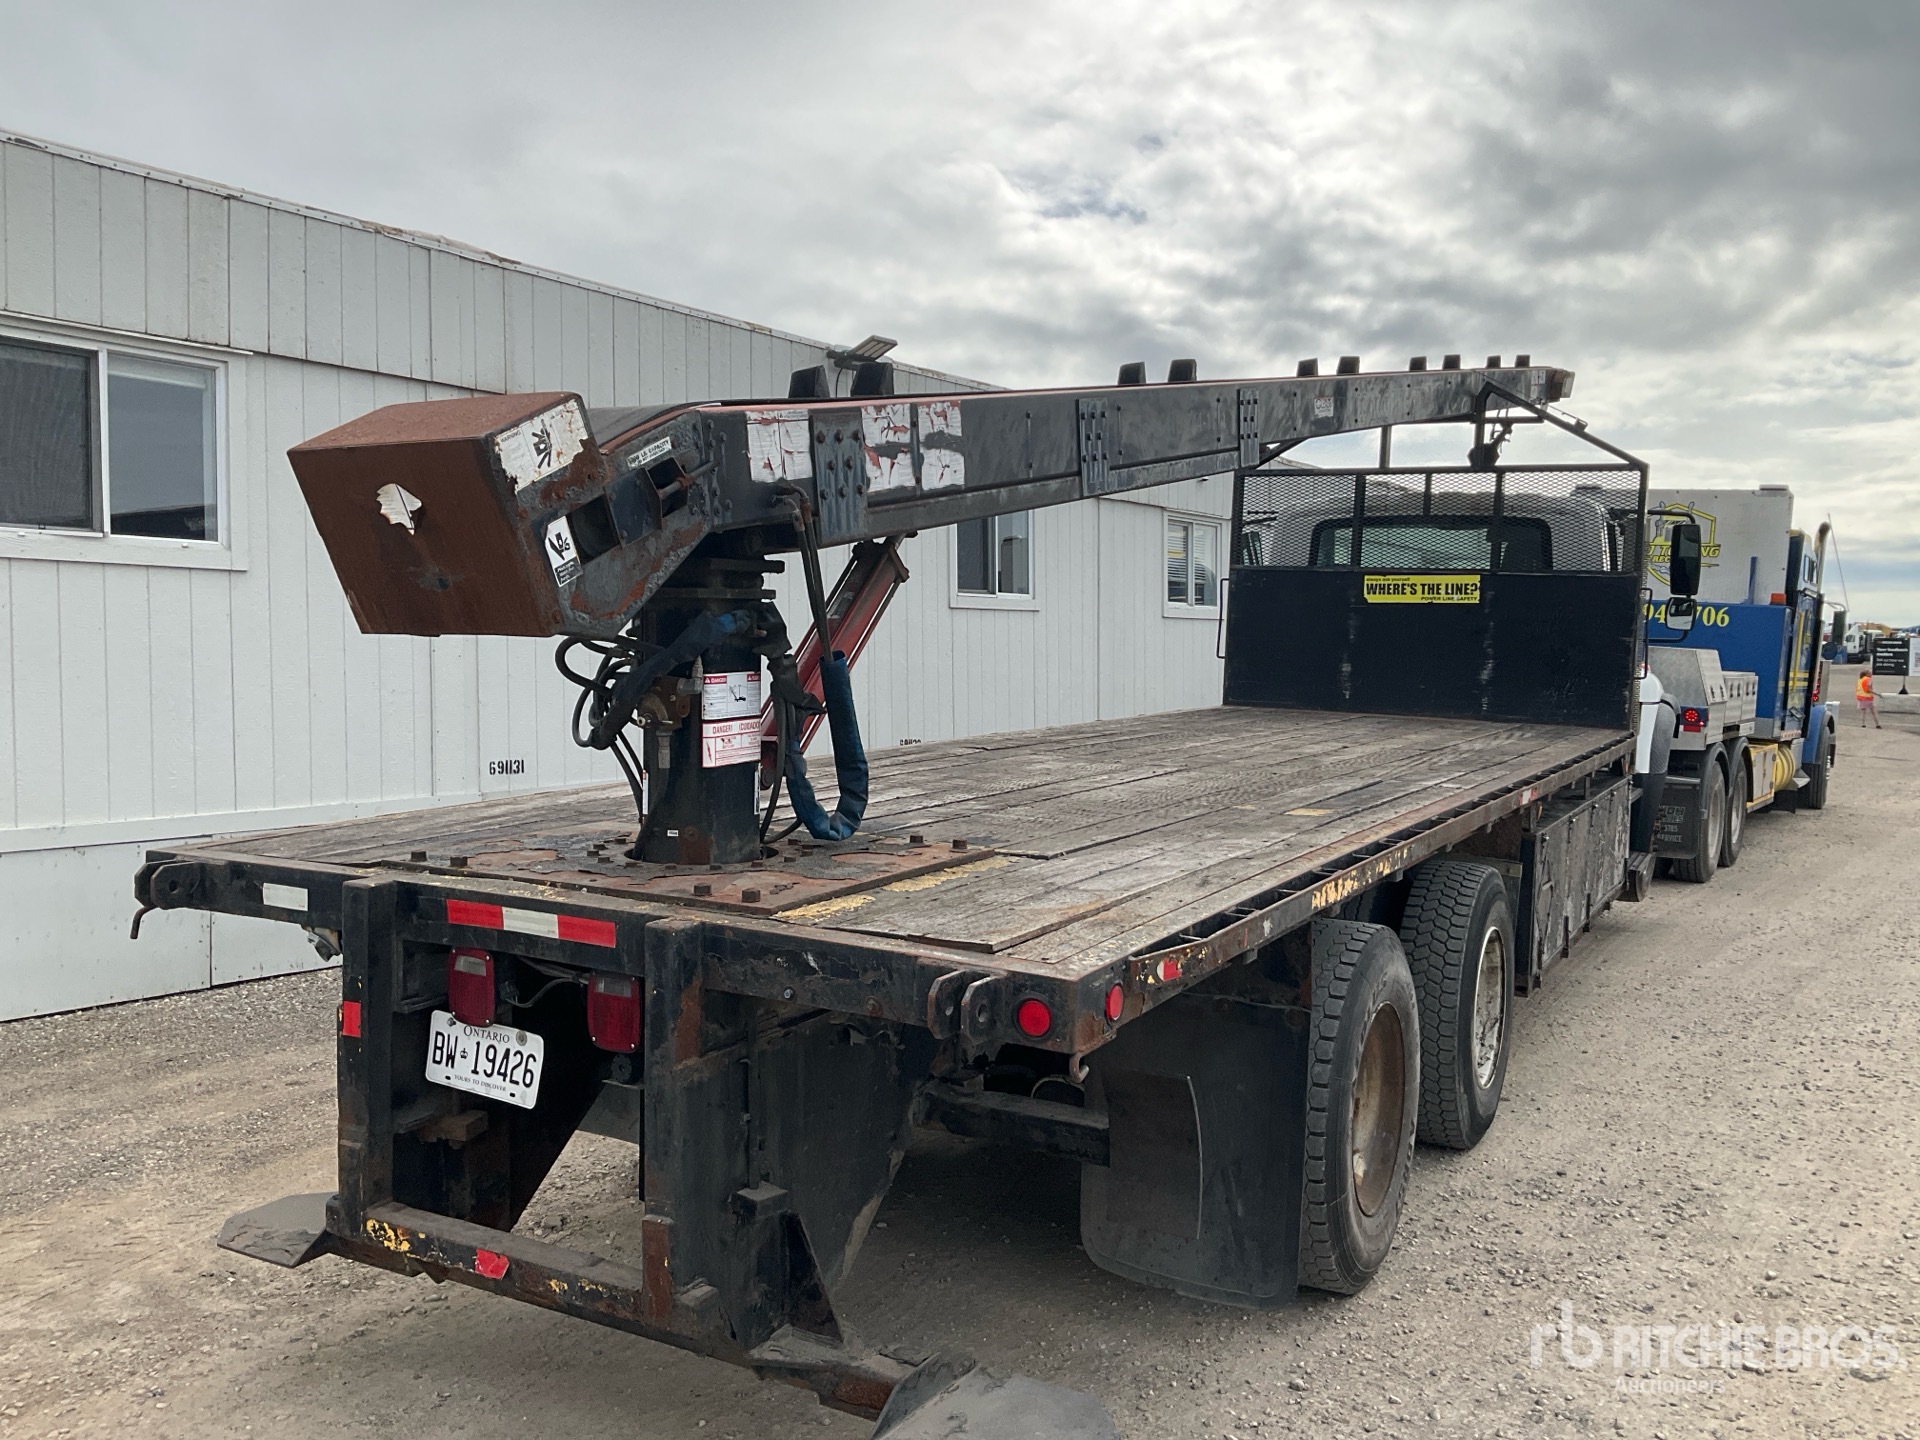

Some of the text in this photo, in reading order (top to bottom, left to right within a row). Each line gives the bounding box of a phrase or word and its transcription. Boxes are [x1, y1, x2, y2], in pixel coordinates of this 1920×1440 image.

[501, 429, 521, 442] WARNING
[648, 440, 669, 453] CAPACITY
[1366, 583, 1478, 595] WHERE'S THE LINE?
[712, 725, 733, 734] DANGER!
[489, 759, 525, 775] 691131
[463, 1025, 510, 1044] ONTARIO
[432, 1031, 537, 1088] BW 19426
[454, 1074, 471, 1084] YOURS
[480, 1081, 507, 1092] DISCOVER
